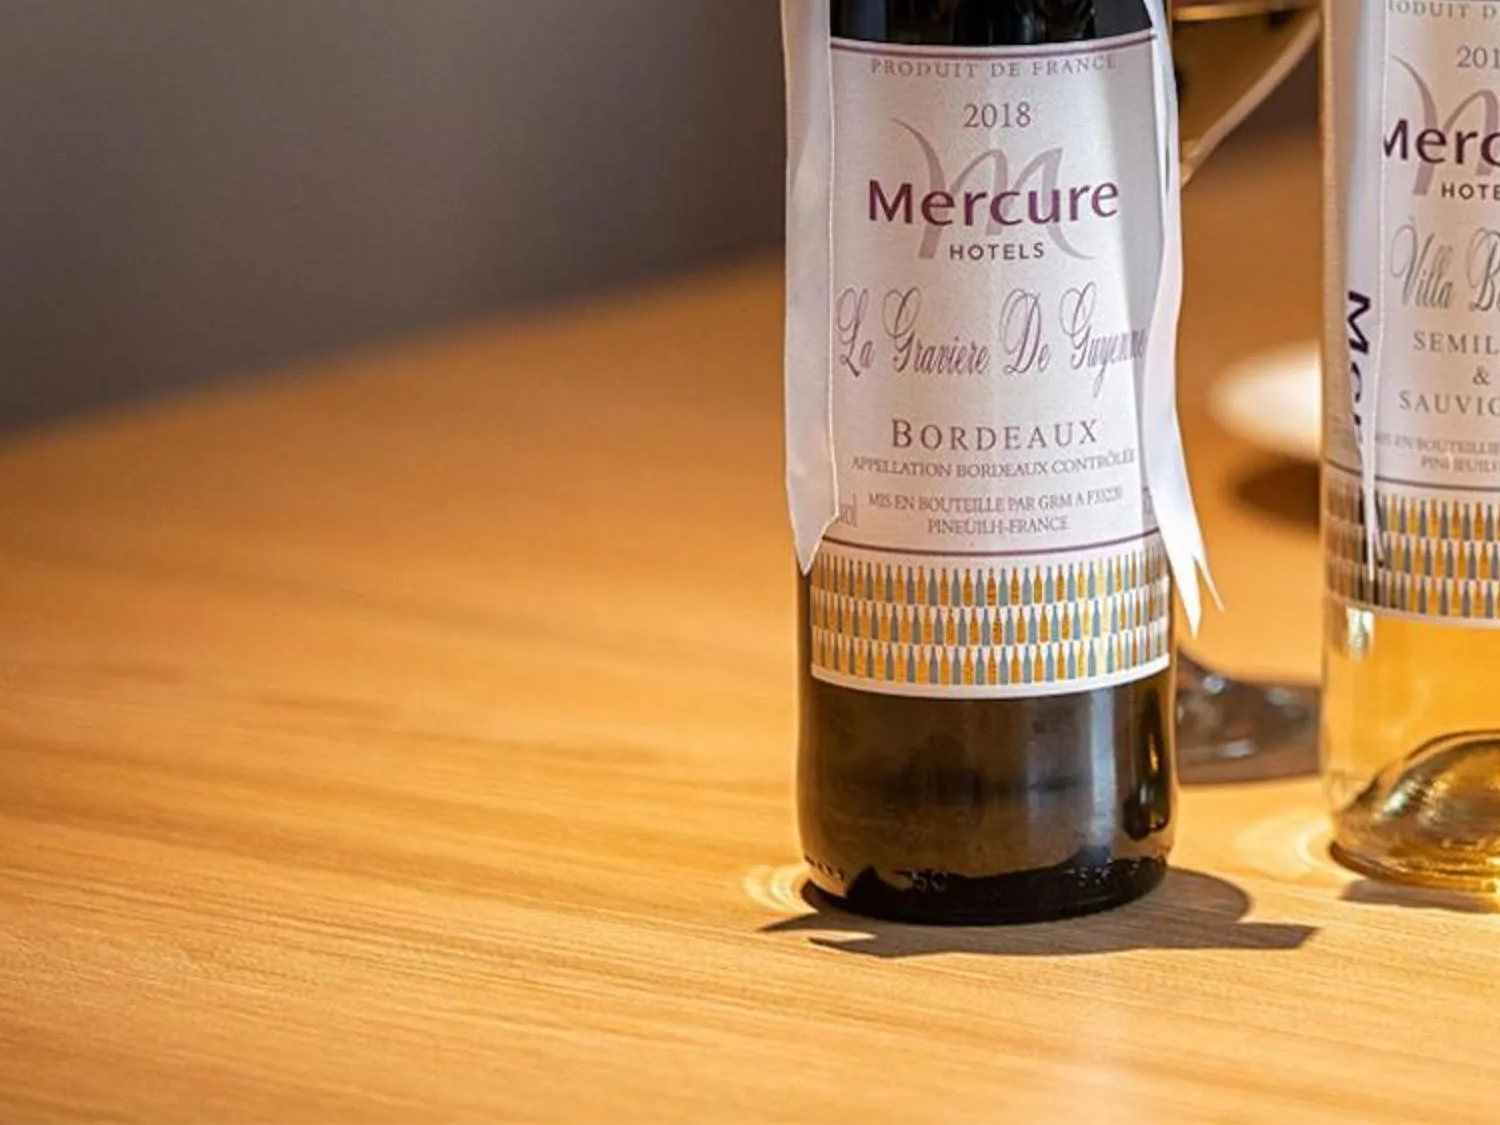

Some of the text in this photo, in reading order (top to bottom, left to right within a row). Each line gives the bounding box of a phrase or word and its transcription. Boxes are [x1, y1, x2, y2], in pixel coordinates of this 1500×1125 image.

[871, 54, 1118, 78] PRODUIT DE FRANCE
[963, 102, 1032, 129] 2018
[868, 179, 1120, 227] Mercure
[949, 242, 1046, 261] HOTELS
[1389, 222, 1454, 312] Villa
[837, 288, 875, 377] La
[1001, 288, 1052, 374] De
[1472, 365, 1491, 386] &
[892, 419, 1100, 452] BORDEAUX
[851, 456, 950, 478] APPELLATION
[957, 463, 1048, 478] BORDEAUX
